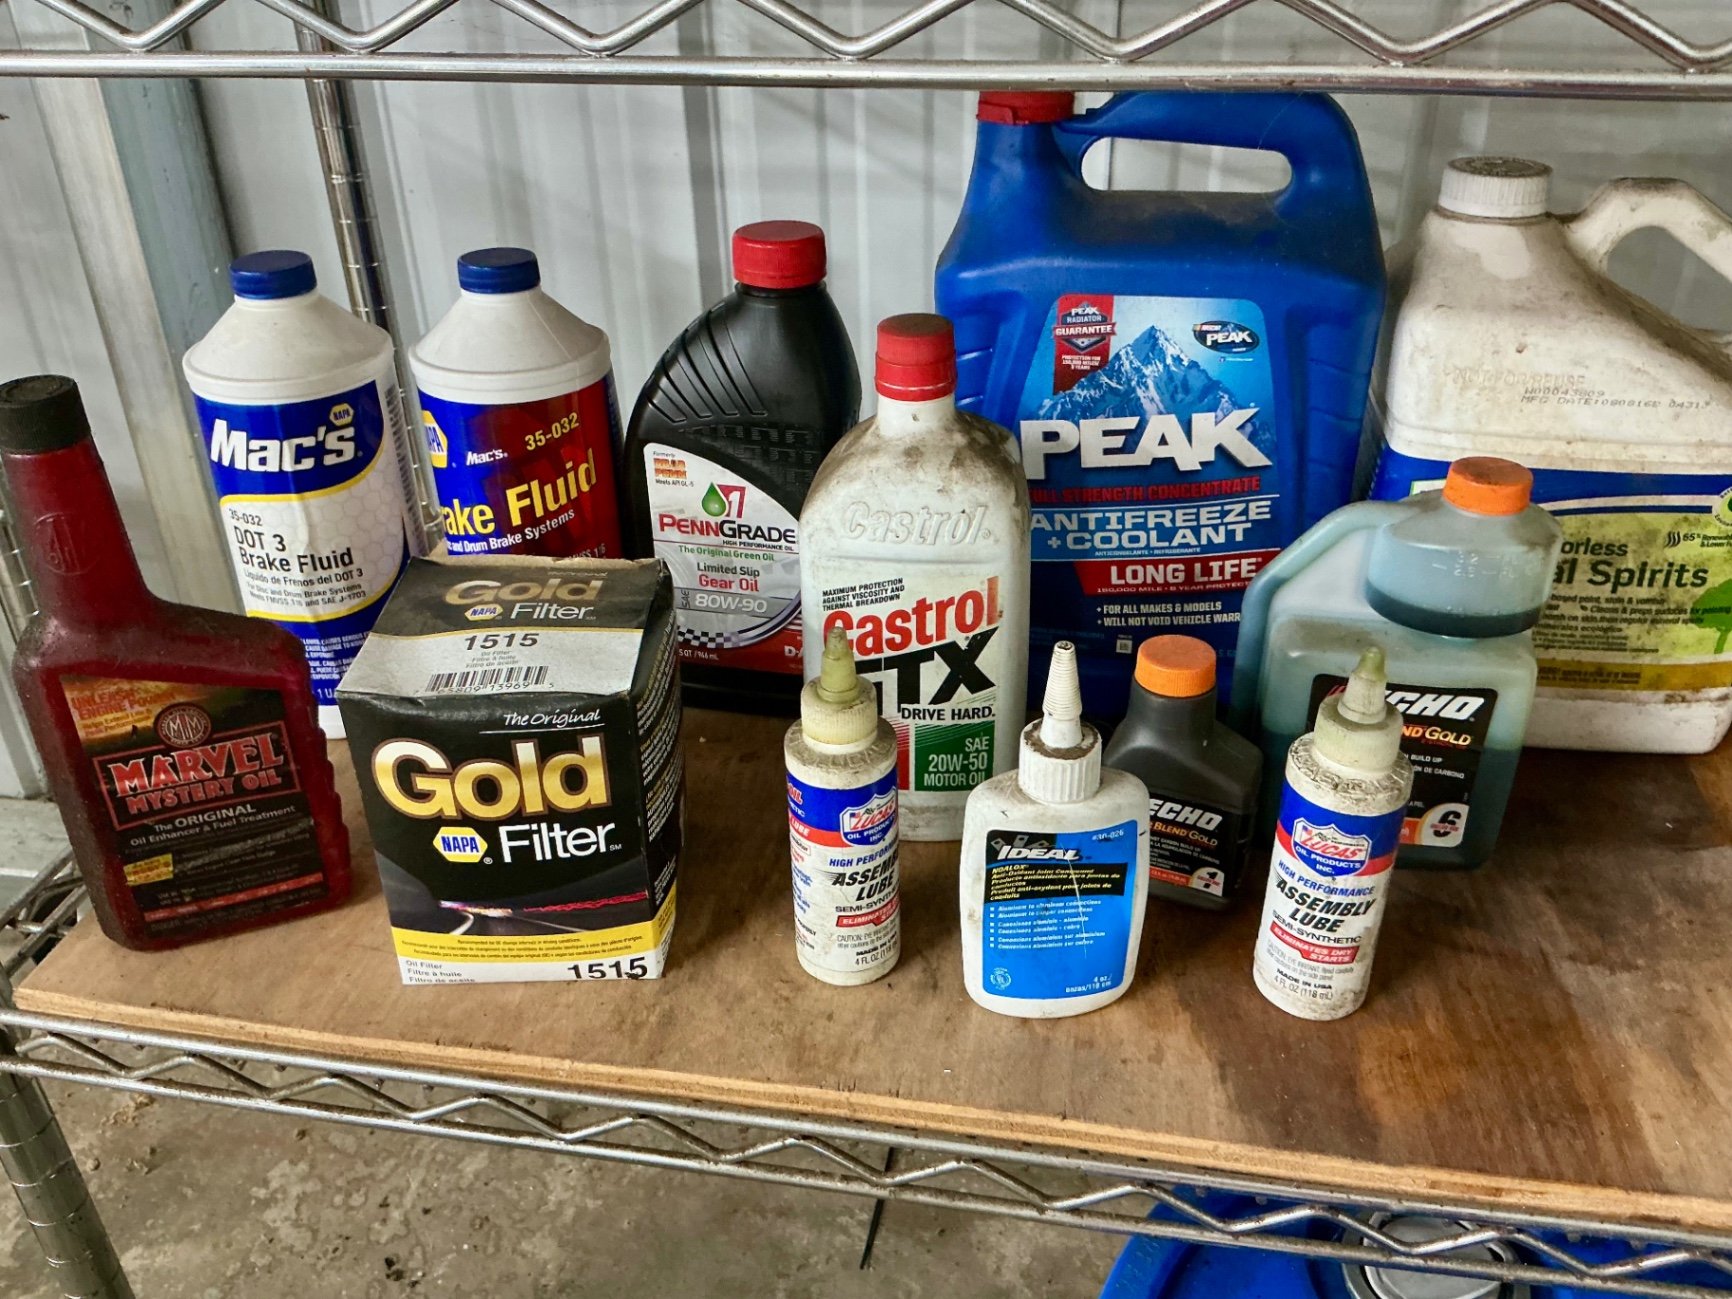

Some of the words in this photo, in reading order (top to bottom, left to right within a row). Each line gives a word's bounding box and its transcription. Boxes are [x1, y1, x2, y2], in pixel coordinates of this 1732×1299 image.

[1055, 325, 1112, 336] GUARANTEE
[1206, 331, 1253, 346] PEAK
[524, 412, 580, 451] 35-032
[210, 419, 355, 472] Mac's
[1020, 408, 1273, 480] PEAK
[466, 449, 504, 466] Mac's
[506, 448, 597, 527] Fluid
[1062, 484, 1143, 503] STRENGTH
[1148, 475, 1261, 499] CONCENTRATE
[229, 509, 262, 526] 35-032
[845, 501, 987, 546] Castrol
[1031, 501, 1272, 531] ANTIFREEZE
[234, 525, 265, 551] DOT
[273, 534, 287, 551] 3
[463, 540, 488, 553] Drum
[489, 532, 523, 550] Brake
[524, 508, 576, 541] Systems
[658, 513, 796, 544] PENNGRADE
[679, 545, 695, 554] The
[697, 546, 733, 558] Original
[733, 549, 760, 560] Green
[762, 553, 775, 561] Oil
[738, 540, 783, 550] PERFORMANCE
[1561, 537, 1629, 557] orless
[240, 547, 291, 573] Brake
[299, 547, 354, 573] Fluid
[697, 562, 737, 575] Limited
[740, 566, 760, 577] Slip
[283, 577, 315, 587] Frenos
[318, 575, 333, 585] del
[335, 571, 354, 583] DOT
[357, 568, 364, 577] 3
[1110, 564, 1186, 585] LONG
[1194, 558, 1257, 583] LIFE
[1587, 559, 1710, 593] Spirits
[445, 578, 603, 604] Gold
[699, 574, 735, 589] Gear
[739, 578, 759, 592] Oil
[823, 585, 857, 597] MAXIMUM
[858, 577, 904, 592] PROTECTION
[1206, 581, 1251, 589] PROTECT
[695, 593, 768, 613] 80W-90
[823, 594, 850, 604] AGAINST
[852, 588, 889, 600] VISCOSITY
[890, 584, 905, 594] AND
[823, 601, 853, 611] THERMAL
[856, 593, 901, 607] BREAKDOWN
[470, 607, 498, 617] NAPA
[510, 603, 594, 620] Filter
[823, 575, 1000, 657] Castrol
[1103, 605, 1121, 614] FOR
[1122, 604, 1138, 614] ALL
[1140, 604, 1173, 613] MAKES
[1175, 603, 1182, 612] &
[1183, 602, 1222, 612] MODELS
[1104, 617, 1127, 626] WILL
[1128, 617, 1146, 626] NOT
[1147, 616, 1171, 626] VOID
[1173, 614, 1212, 625] VEHICLE
[1213, 613, 1241, 623] WARR
[465, 633, 540, 650] 1515
[901, 704, 946, 721] DRIVE
[1386, 690, 1485, 721] CHO
[503, 712, 528, 726] The
[532, 709, 602, 729] Original
[965, 736, 990, 751] SAE
[1425, 726, 1472, 746] GOLD
[108, 732, 285, 797] MARVEL
[928, 753, 988, 772] 20W-50
[1411, 754, 1431, 762] BUILD
[372, 734, 611, 820] Gold
[923, 772, 966, 787] MOTOR
[969, 771, 987, 786] OIL
[1434, 768, 1465, 779] CARBONO
[126, 777, 235, 815] MYSTERY
[241, 768, 282, 790] OIL
[154, 823, 173, 832] The
[174, 803, 257, 828] ORIGINAL
[851, 799, 896, 831] LUCAS
[1150, 799, 1223, 831] ECHO
[1433, 810, 1462, 838] 6
[130, 838, 146, 847] Oil
[150, 826, 199, 844] Enhancer
[213, 818, 237, 831] Fuel
[239, 805, 296, 824] Treatment
[791, 817, 810, 837] LUBE
[847, 832, 862, 840] OIL
[1154, 822, 1187, 837] BLEND
[1189, 831, 1218, 846] GOLD
[440, 835, 479, 854] NAPA
[499, 822, 616, 863] Filter
[869, 833, 884, 843] INC.
[1301, 836, 1364, 860] LUCAS
[829, 858, 853, 868] HIGH
[997, 845, 1080, 861] IDEAL
[1295, 846, 1309, 859] OIL
[1310, 853, 1361, 869] PRODUCTS
[1278, 859, 1295, 880] HIGH
[1297, 876, 1375, 897] PERFORMANCE
[1316, 863, 1334, 874] INC.
[856, 870, 895, 902] LUBE
[1276, 878, 1377, 916] ASSEMBLY
[1272, 910, 1363, 944] SEMI-SYNTHETIC
[1289, 907, 1344, 933] LUBE
[1273, 926, 1329, 955] ELIMINATES
[1330, 948, 1353, 956] DRY
[567, 956, 648, 980] 1515
[1309, 953, 1350, 962] STARTS
[407, 968, 430, 976] Filtre
[1276, 968, 1300, 984] MADE
[1279, 978, 1287, 989] FL
[1289, 983, 1299, 993] OZ
[1300, 988, 1317, 999] (118
[1319, 991, 1334, 1000] mL)
